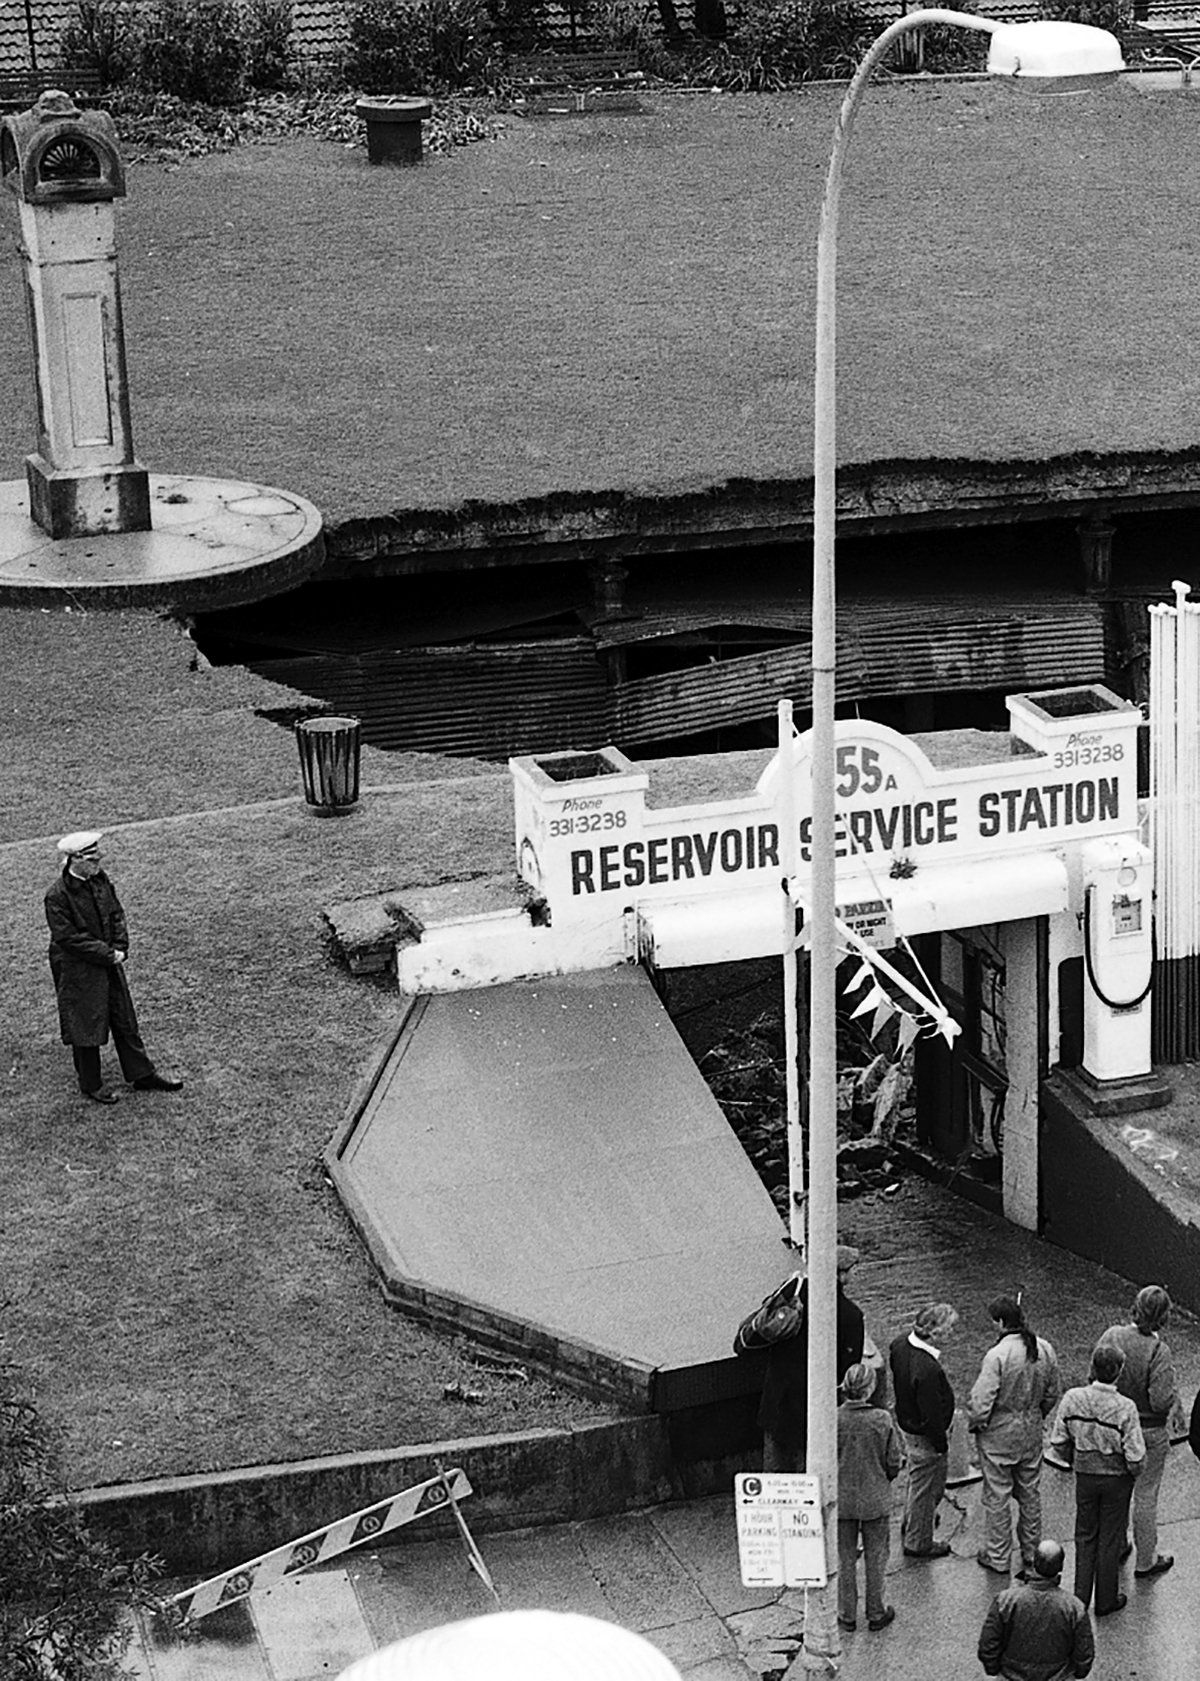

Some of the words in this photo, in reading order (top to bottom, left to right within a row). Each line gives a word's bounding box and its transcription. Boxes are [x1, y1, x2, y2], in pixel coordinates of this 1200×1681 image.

[1066, 732, 1103, 748] Phone
[562, 799, 602, 813] Phone
[571, 823, 780, 896] RESERVOIR
[800, 798, 958, 862] SERVICE
[979, 776, 1119, 838] STATION
[792, 1511, 810, 1526] NO
[742, 1527, 778, 1537] PARKING
[782, 1528, 821, 1538] STANDING
